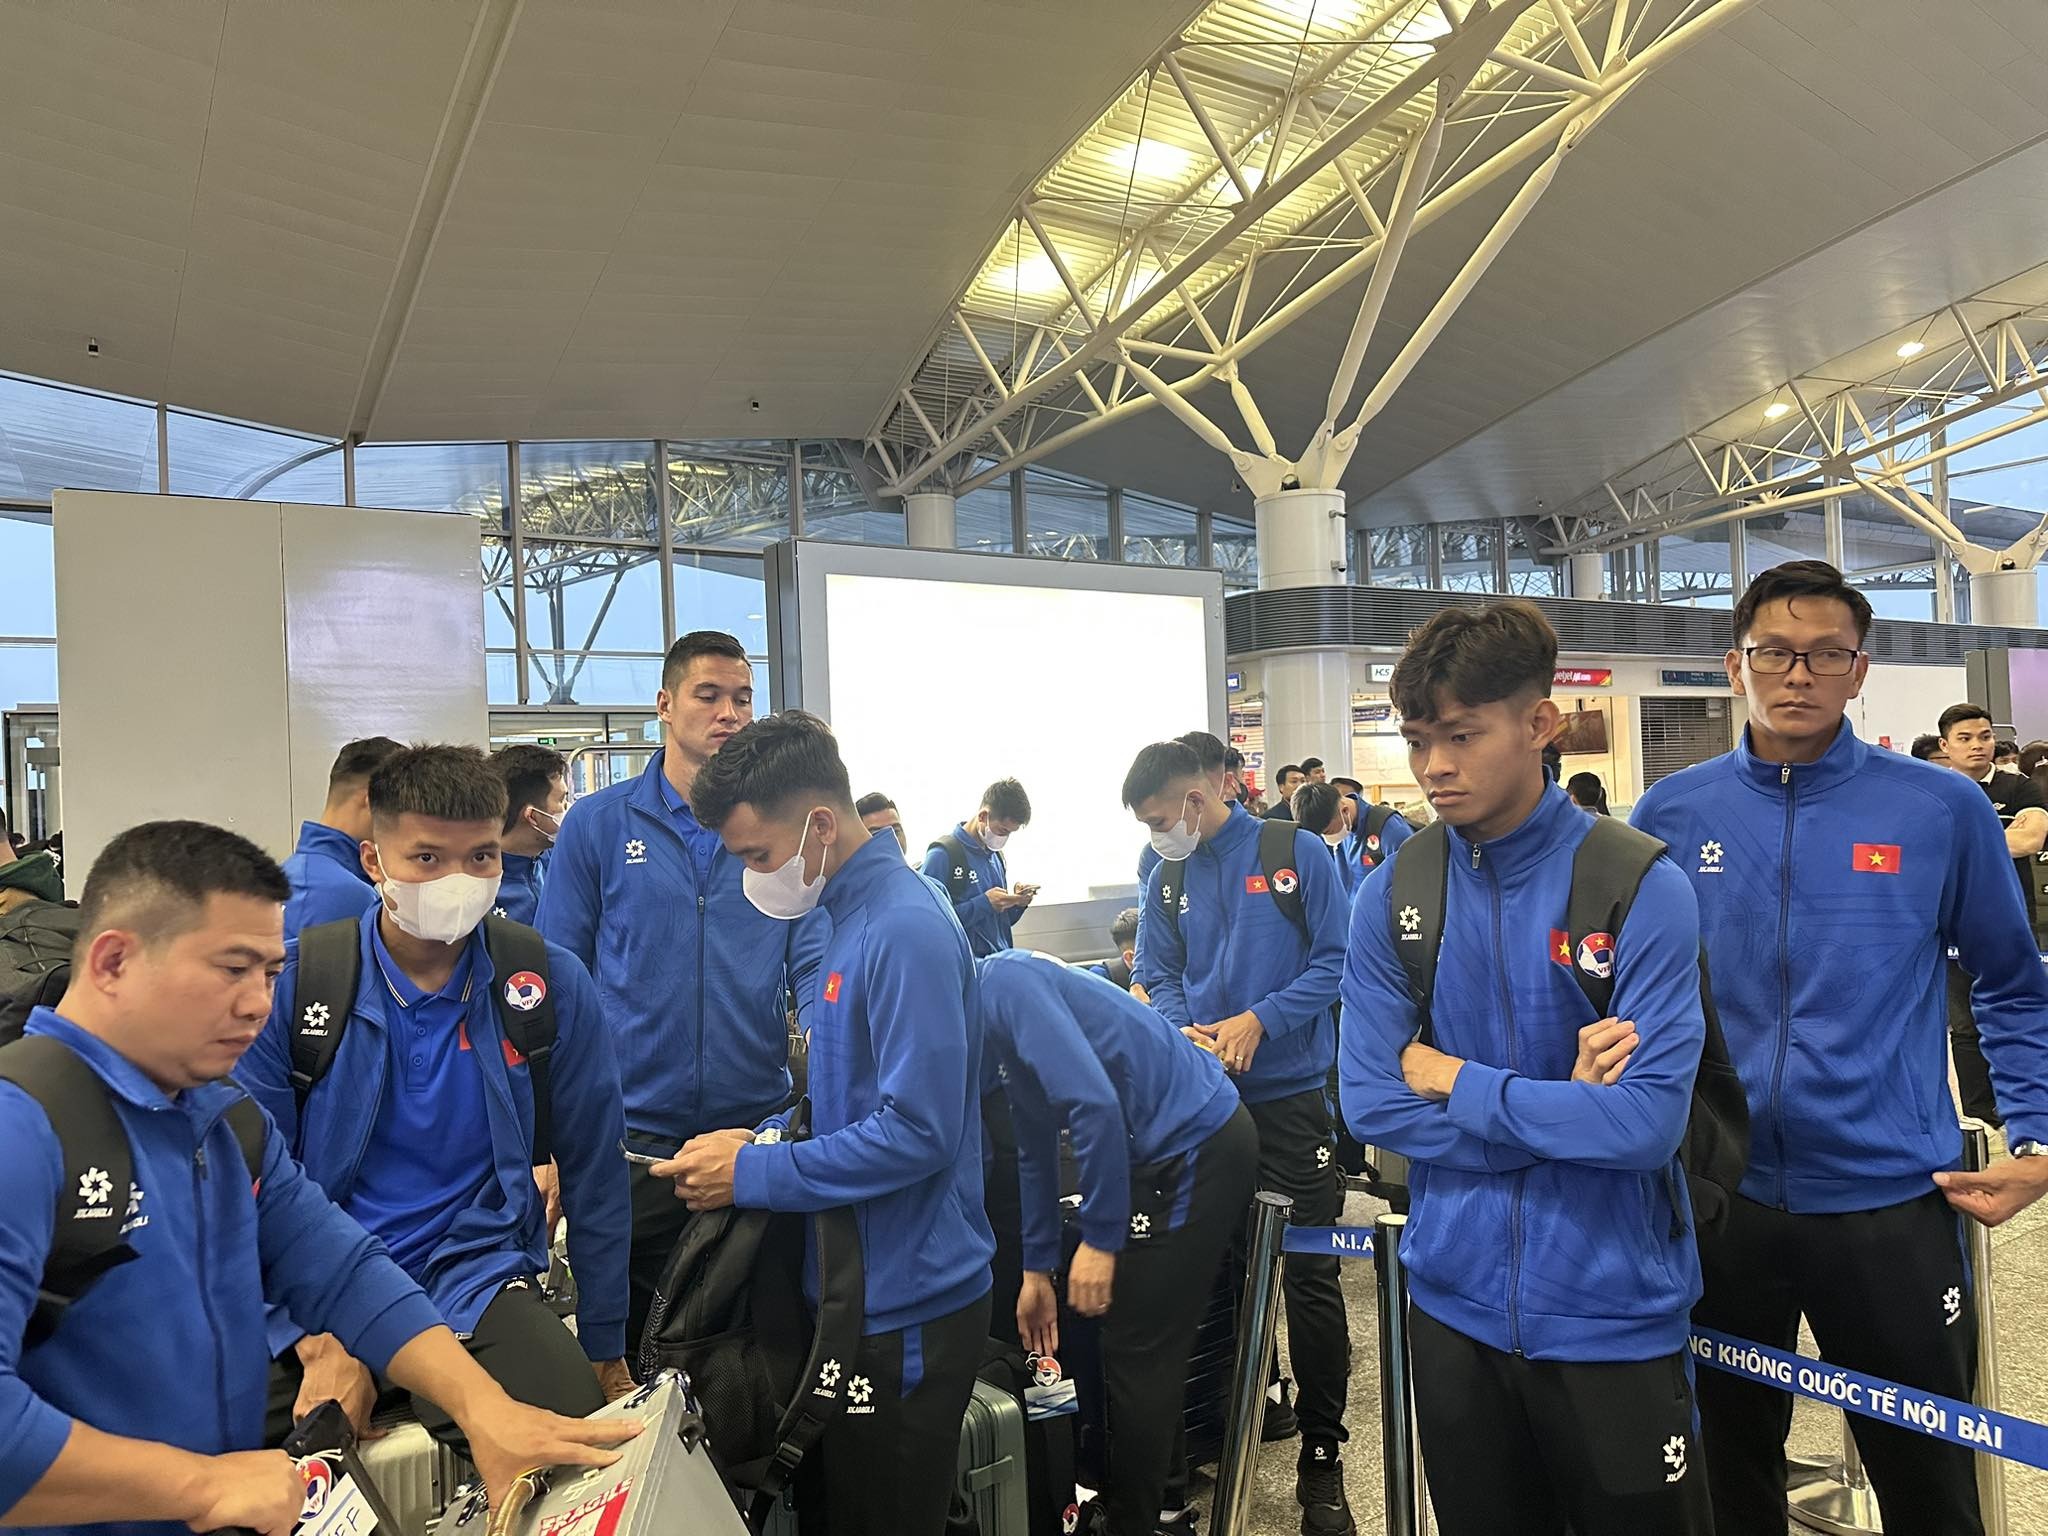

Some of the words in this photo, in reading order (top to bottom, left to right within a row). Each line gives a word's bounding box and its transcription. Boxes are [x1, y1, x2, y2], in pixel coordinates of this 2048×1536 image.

[1718, 1343, 1792, 1384] KHÔNG
[1798, 1368, 1862, 1405] QUỐC
[1867, 1387, 1898, 1417] TẾ
[1902, 1399, 1947, 1434] NỘI
[1957, 1413, 2003, 1450] BÀI
